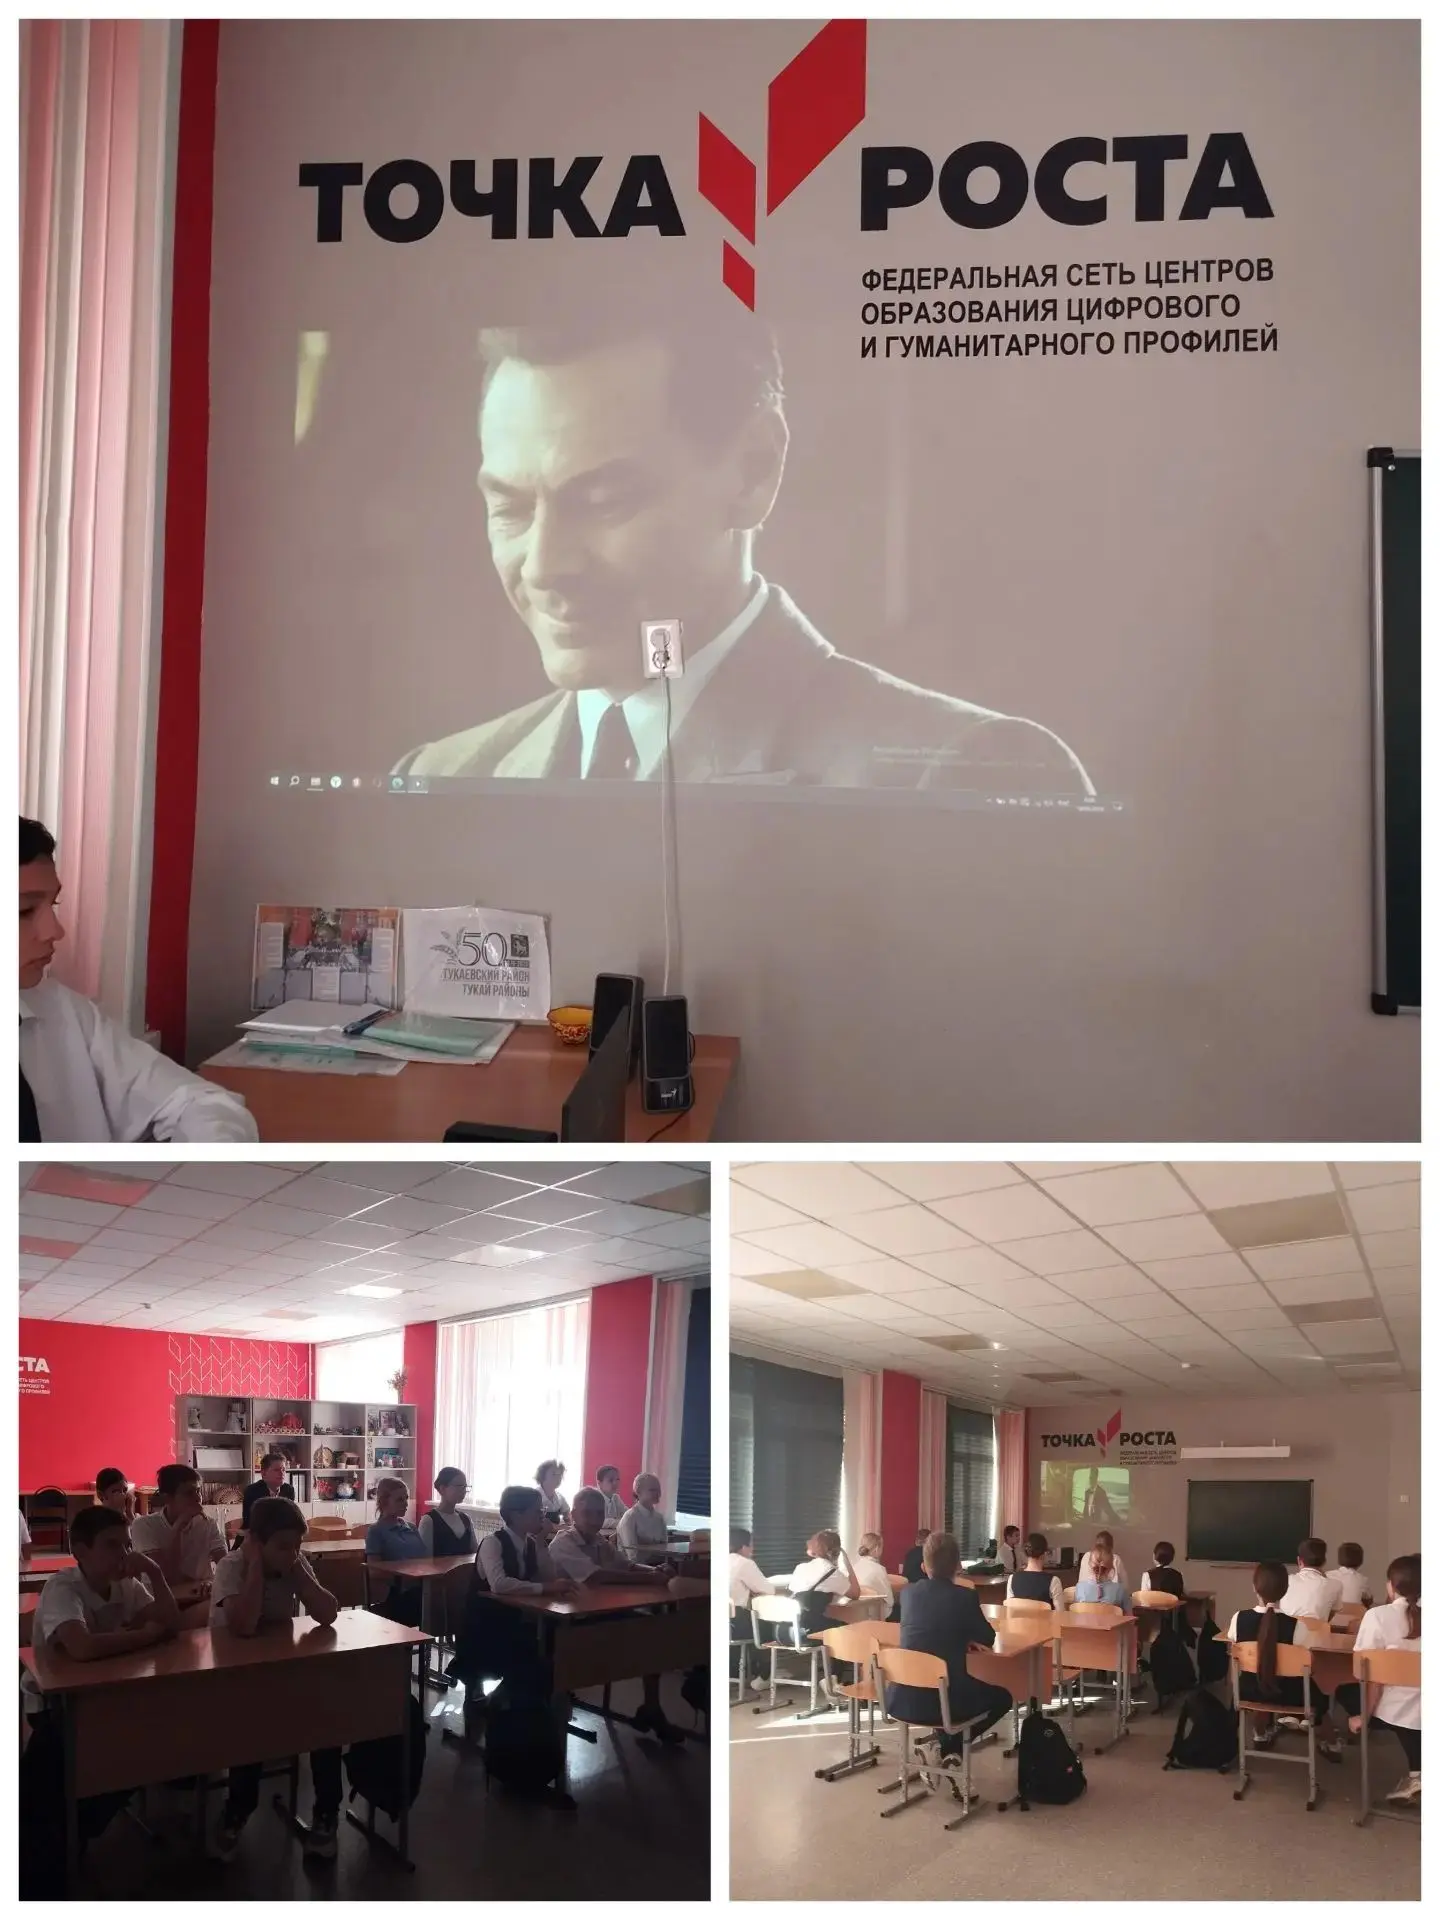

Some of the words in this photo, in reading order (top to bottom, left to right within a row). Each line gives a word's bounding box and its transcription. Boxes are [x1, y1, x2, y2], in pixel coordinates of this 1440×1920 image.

[298, 154, 687, 244] ТОЧКА
[860, 131, 1275, 232] РОСТА
[861, 264, 1058, 295] ФЕДЕРАЛЬНАЯ
[1066, 262, 1136, 287] СЕТЬ
[1145, 257, 1274, 289] ЦЕНТРОВ
[861, 298, 1058, 325] ОБРАЗОВАНИЯ
[1067, 293, 1241, 325] ЦИФРОВОГО
[861, 336, 877, 359] И
[885, 331, 1115, 358] ГУМАНИТАРНОГО
[1124, 322, 1278, 355] ПРОФИЛЕЙ
[458, 932, 508, 967] 50
[442, 968, 500, 981] ТУКАЕВСКИЙ
[501, 969, 530, 982] РАЙОН
[462, 983, 491, 997] ТУКАЙ
[492, 984, 530, 998] РАЙОНЫ
[1041, 1433, 1096, 1448] ТОЧКА
[1119, 1431, 1177, 1447] РОСТА
